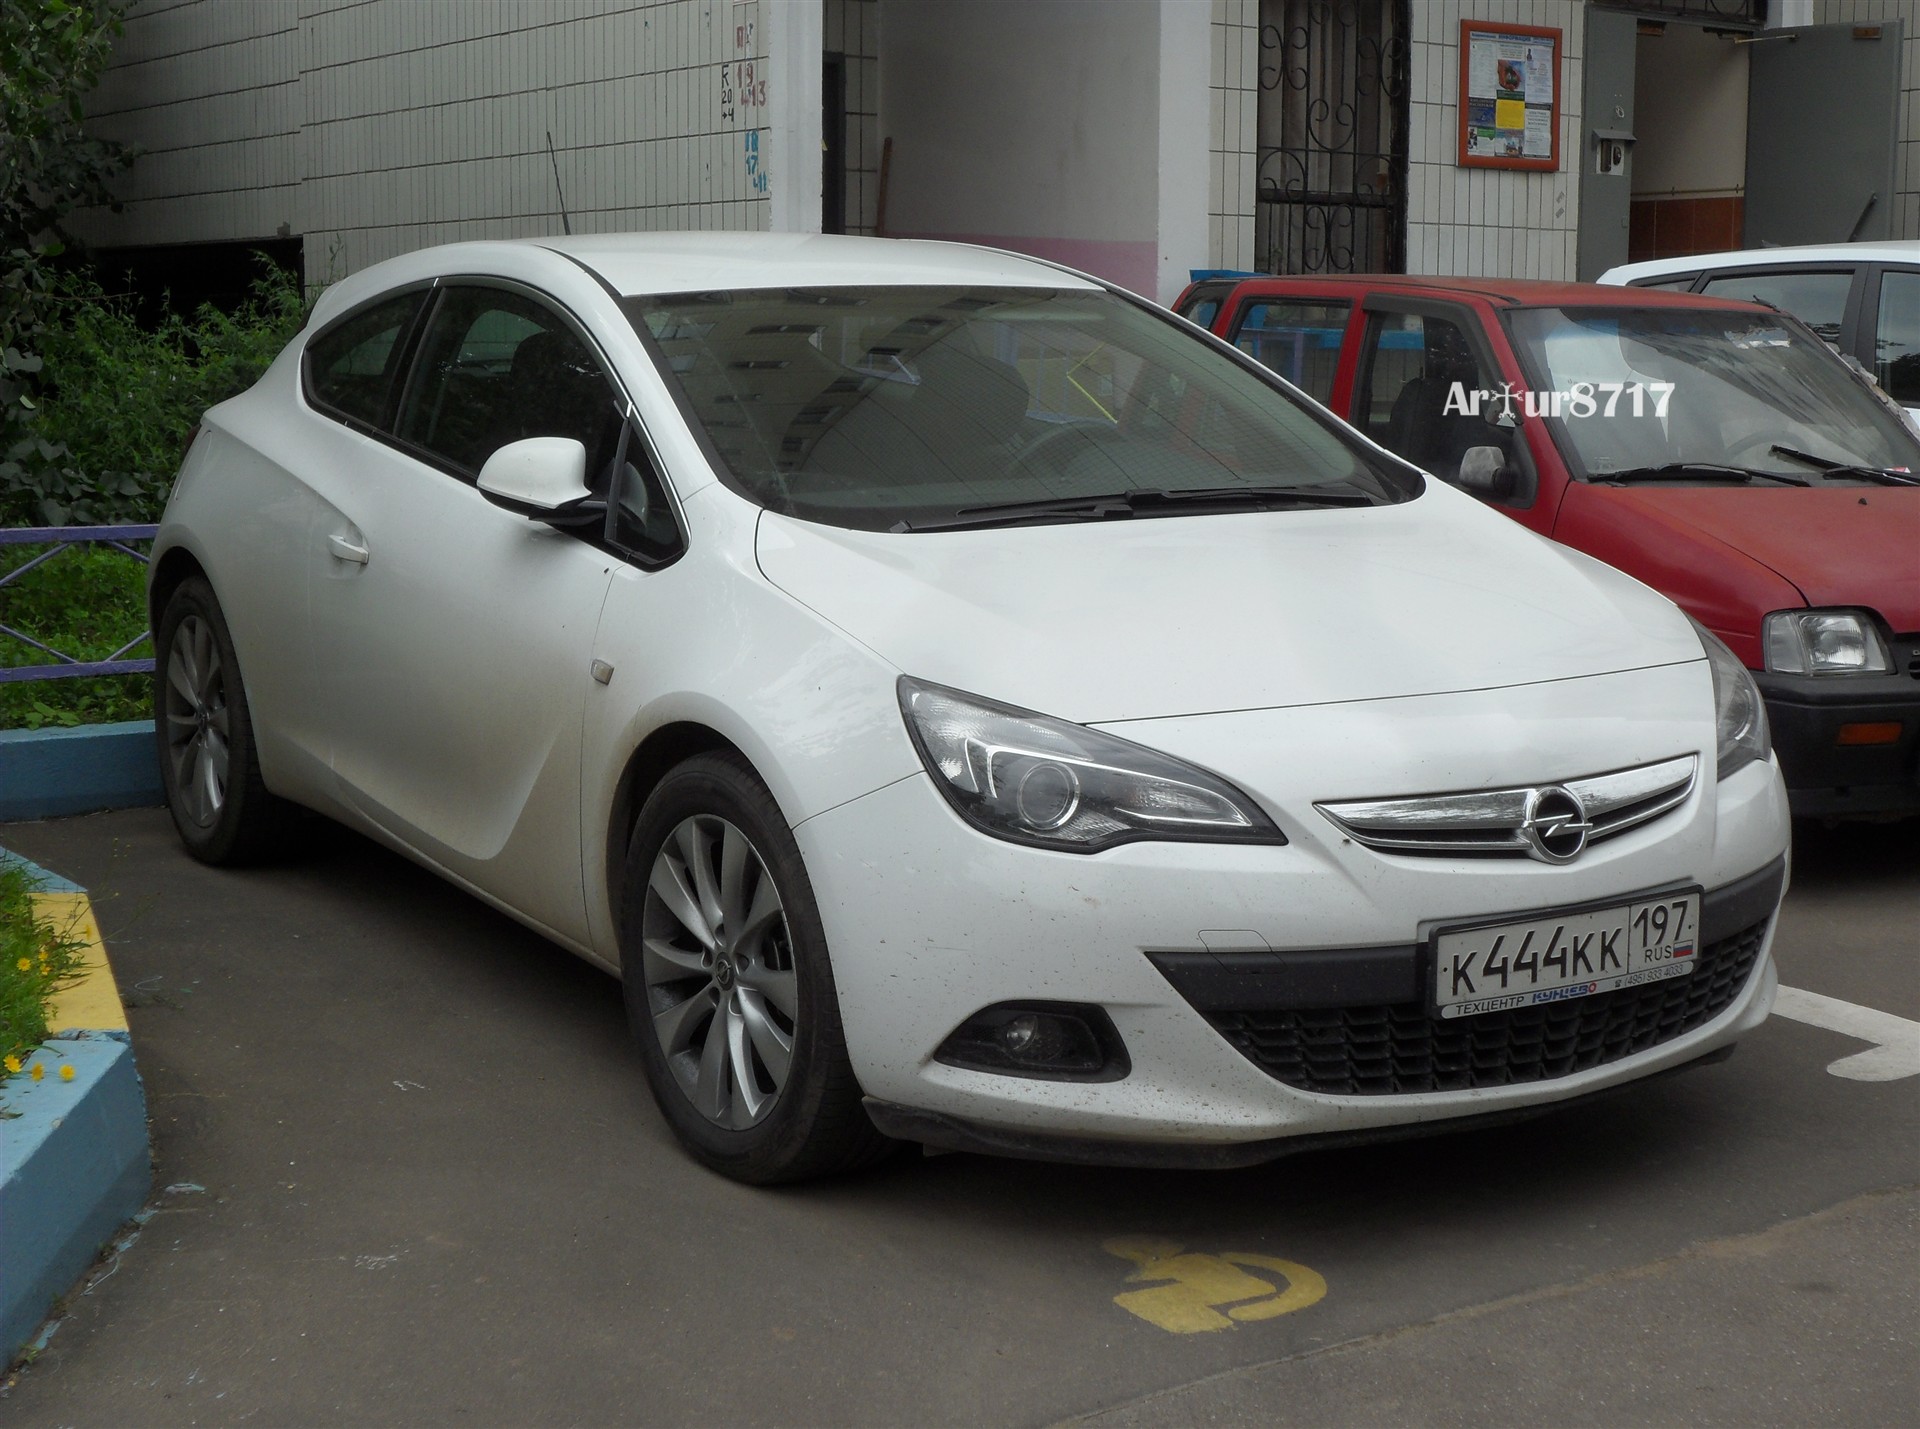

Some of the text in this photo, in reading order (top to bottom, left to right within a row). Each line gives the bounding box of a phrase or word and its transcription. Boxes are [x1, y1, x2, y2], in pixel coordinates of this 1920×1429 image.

[722, 88, 733, 104] 20
[1452, 899, 1689, 996] К444КК 197
[1644, 945, 1672, 963] RUS
[1456, 997, 1524, 1015] ТЕХЦЕНТР
